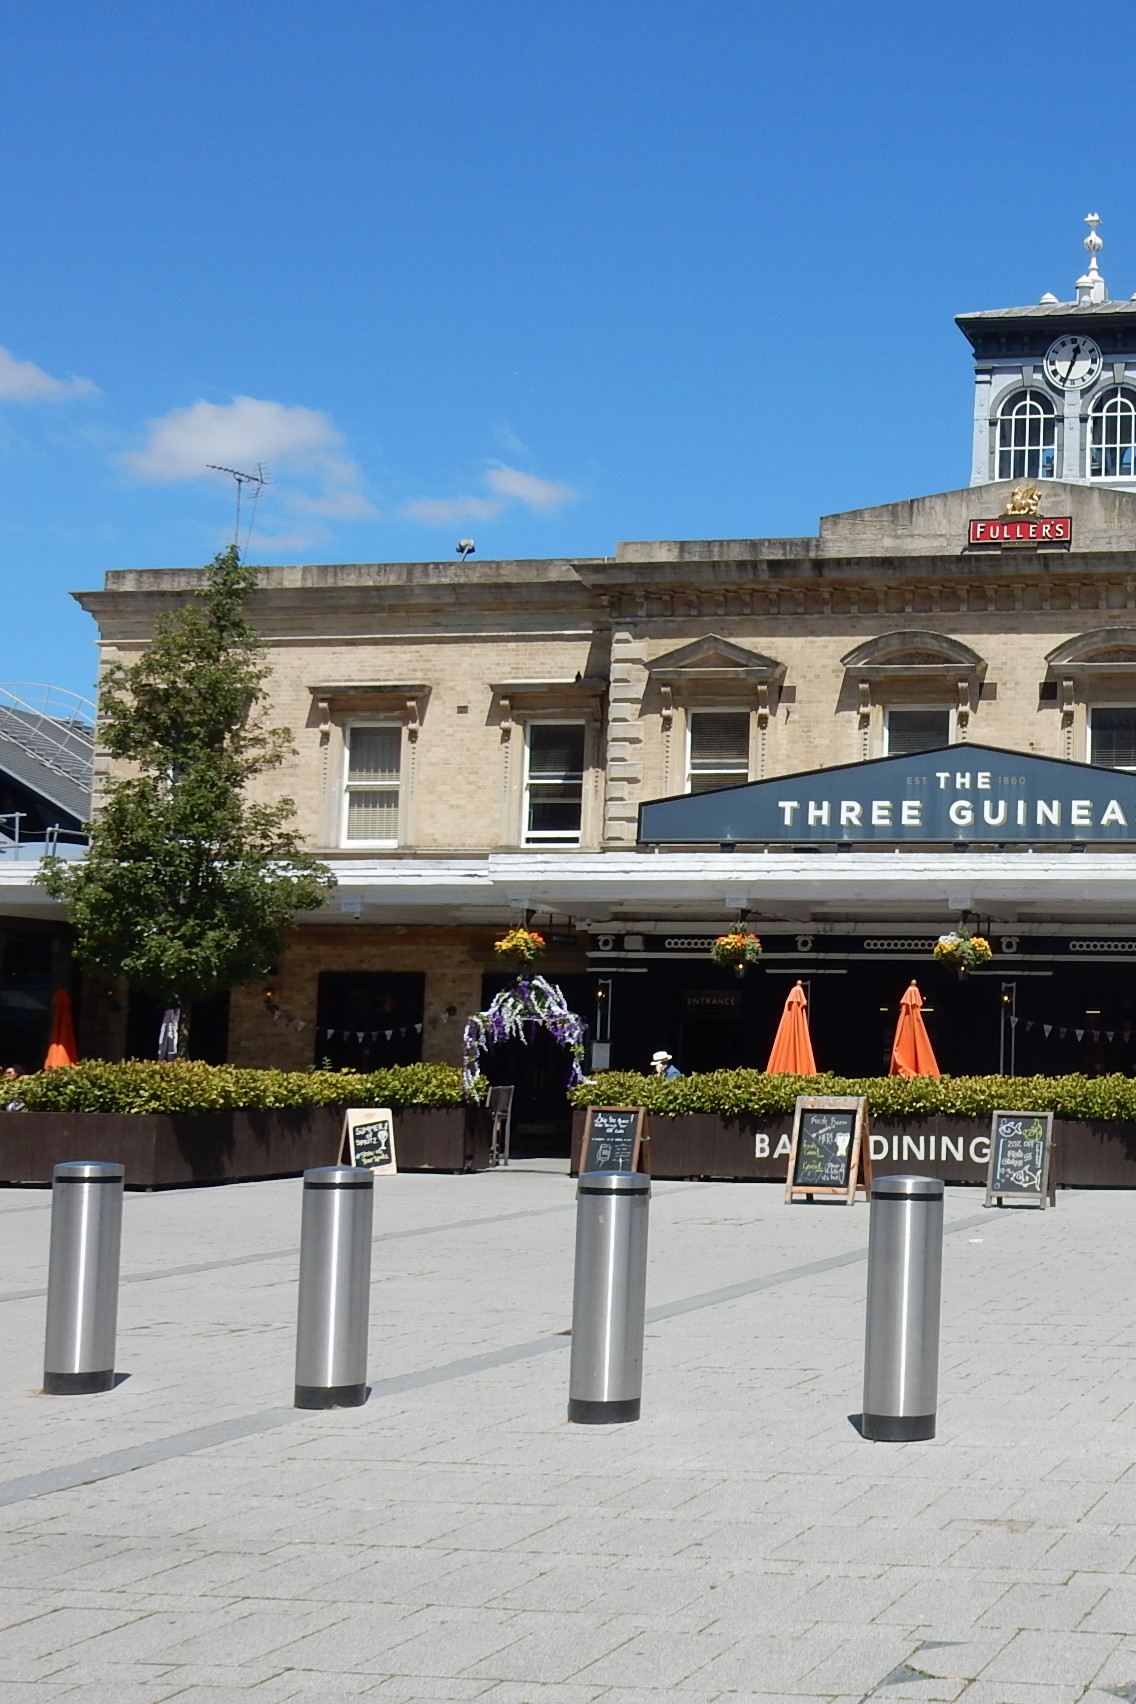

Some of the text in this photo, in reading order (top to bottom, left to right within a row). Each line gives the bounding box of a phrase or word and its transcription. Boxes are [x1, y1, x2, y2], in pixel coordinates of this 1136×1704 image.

[976, 521, 1064, 539] FULLER'S
[936, 772, 991, 790] THE
[998, 776, 1026, 786] 1860
[778, 800, 923, 827] THREE
[687, 997, 736, 1006] ENTRANCE
[755, 1134, 991, 1164] BA DINING
